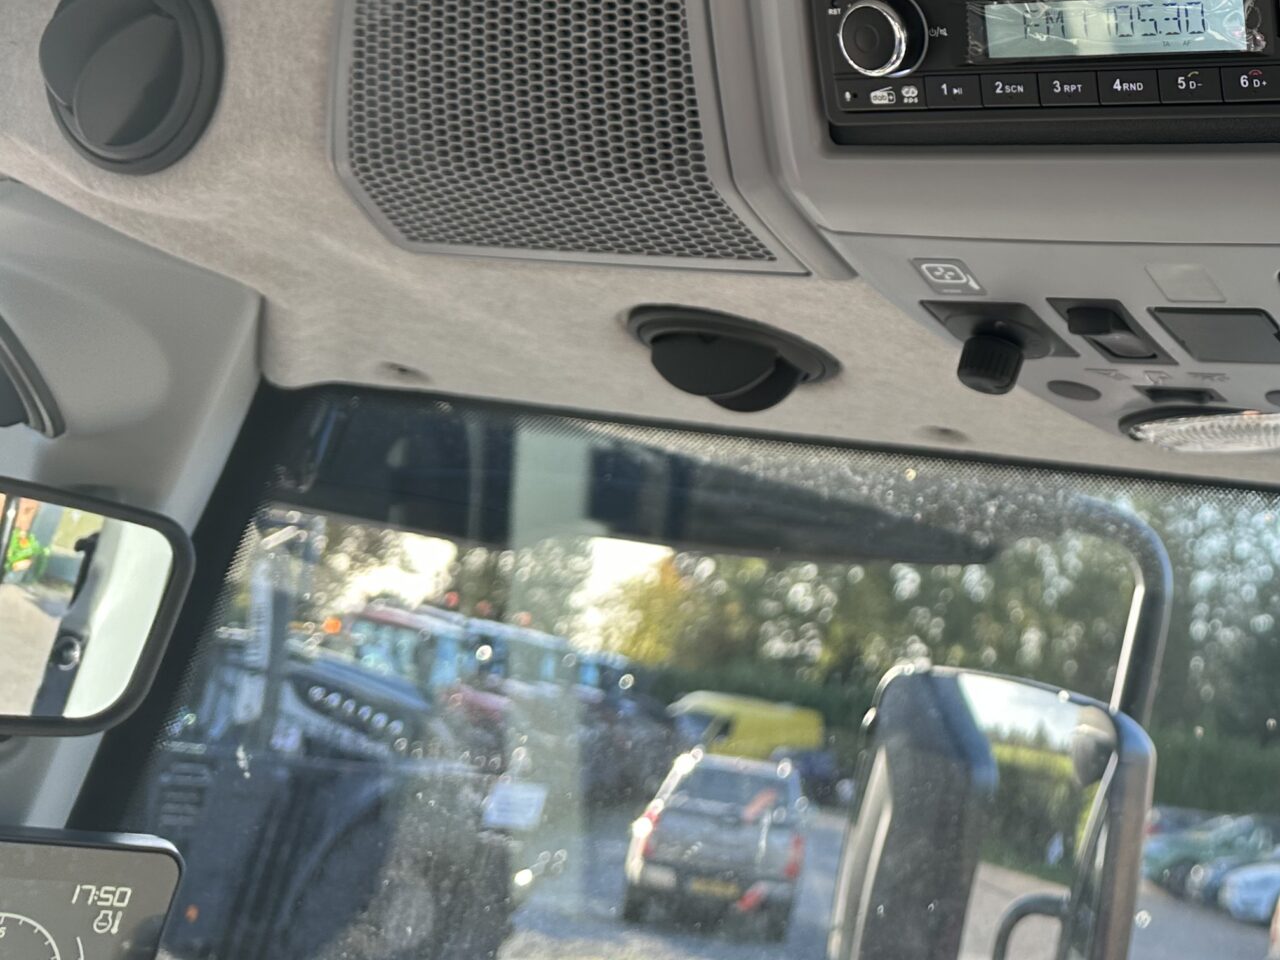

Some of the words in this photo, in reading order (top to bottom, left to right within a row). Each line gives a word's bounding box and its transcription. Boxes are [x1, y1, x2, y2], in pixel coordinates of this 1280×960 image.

[828, 8, 841, 16] RST
[994, 81, 1003, 94] 2
[1004, 84, 1024, 93] SCN
[1053, 80, 1061, 93] 3
[1063, 84, 1082, 93] RPT
[1113, 78, 1121, 91] 4
[1122, 82, 1144, 91] RND
[1177, 76, 1186, 89] 5
[1240, 74, 1249, 88] 6
[941, 83, 948, 95] 1
[72, 884, 132, 908] 17:50
